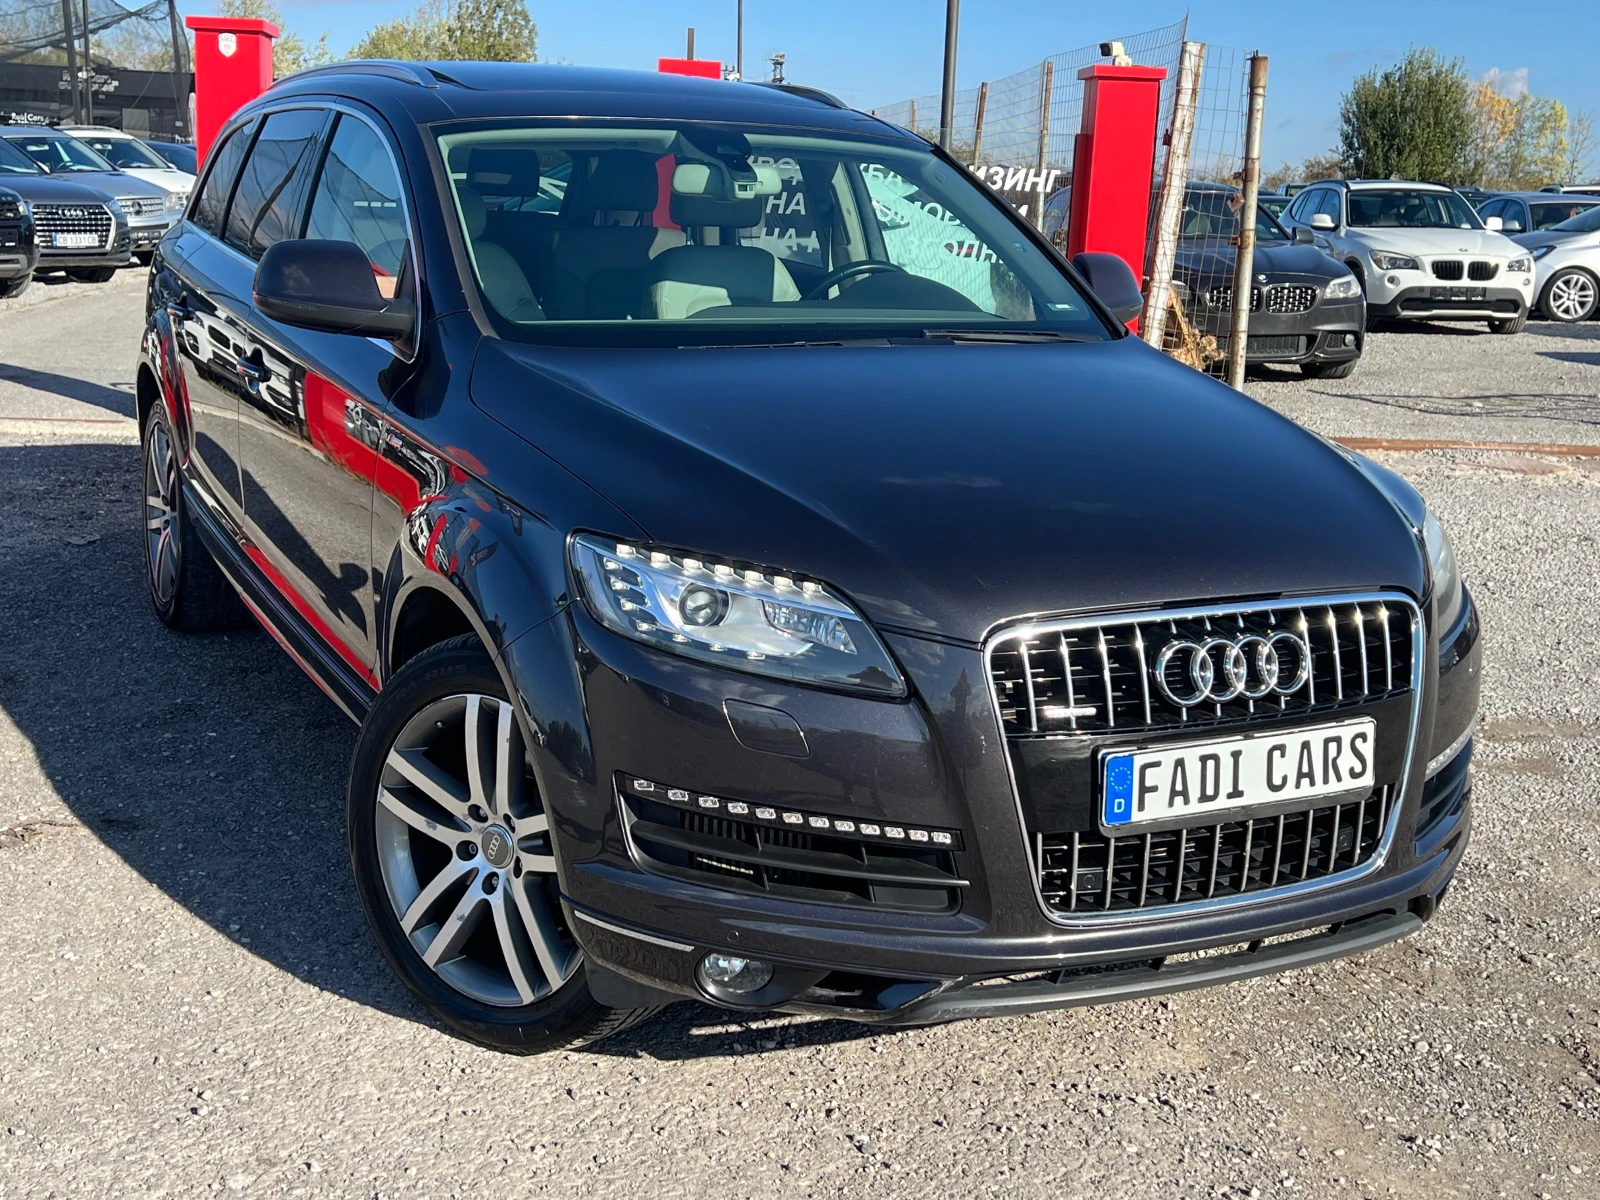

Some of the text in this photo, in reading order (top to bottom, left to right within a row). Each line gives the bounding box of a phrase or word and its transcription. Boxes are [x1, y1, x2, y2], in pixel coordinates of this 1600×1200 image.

[765, 191, 806, 216] НА
[760, 227, 798, 252] НА
[1137, 731, 1368, 812] FADI CARS
[1113, 798, 1125, 814] D
